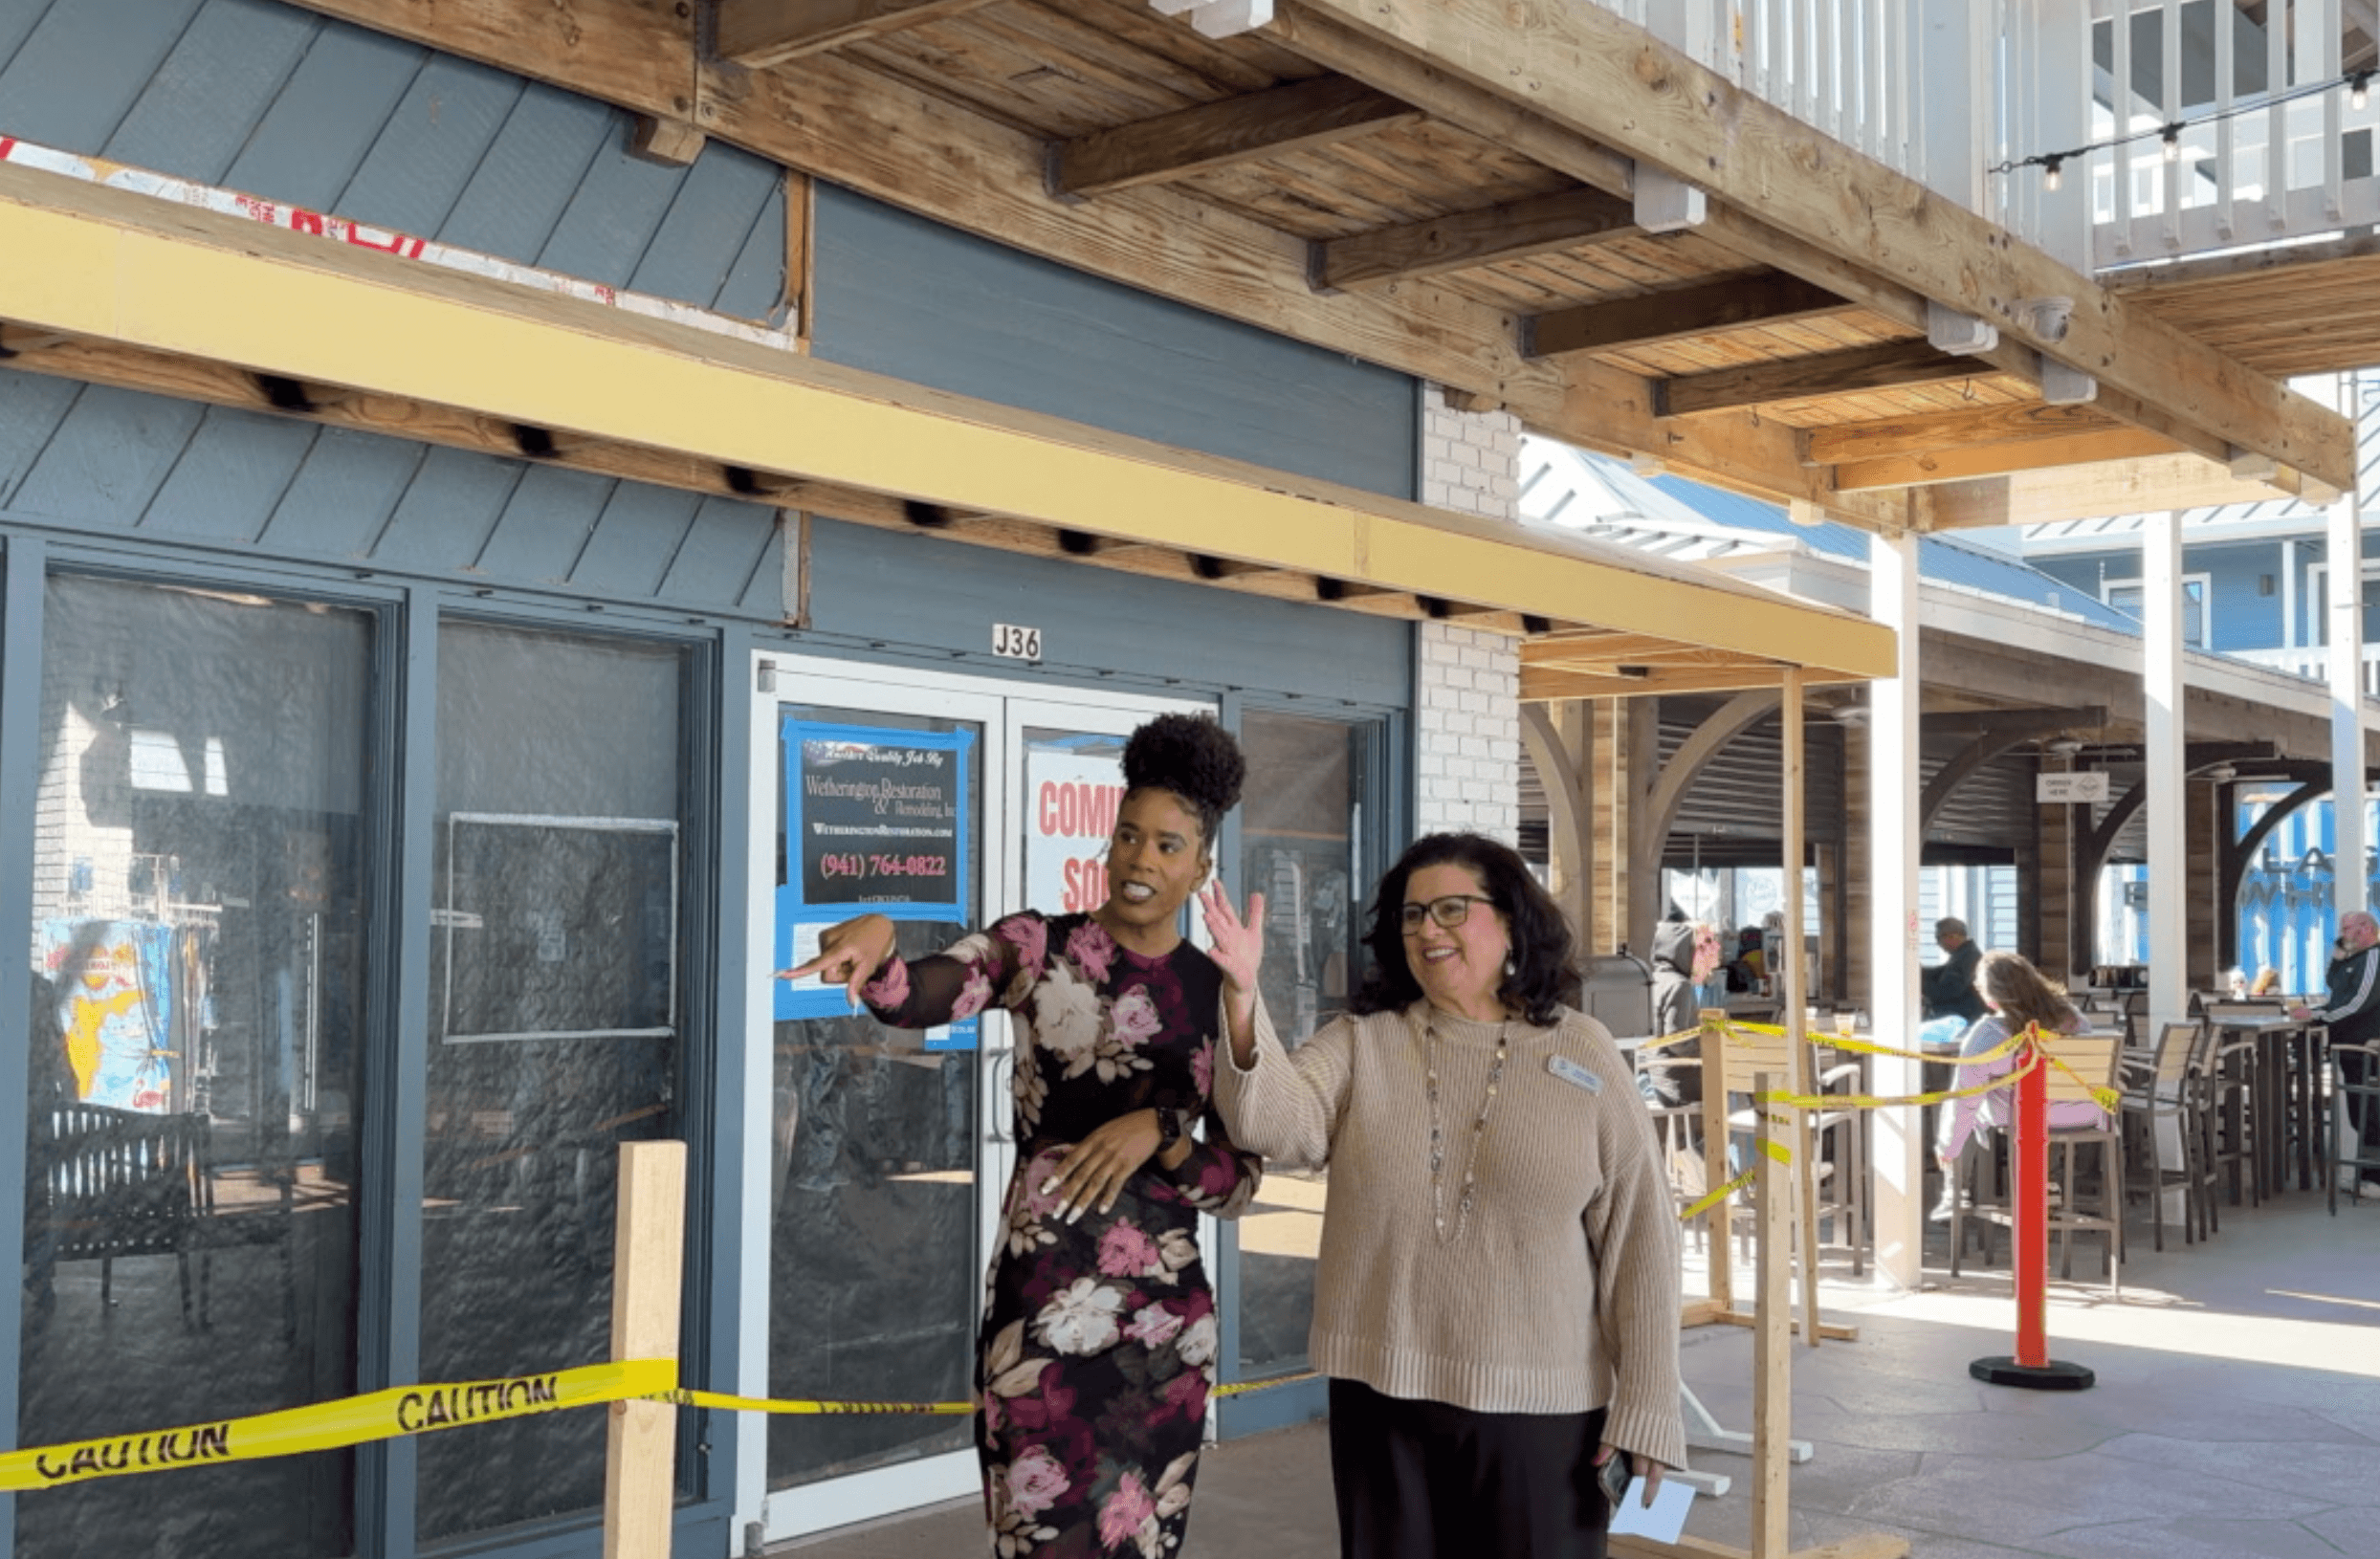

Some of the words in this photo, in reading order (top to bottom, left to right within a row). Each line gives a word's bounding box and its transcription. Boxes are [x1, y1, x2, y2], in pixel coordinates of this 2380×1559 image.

[996, 626, 1040, 657] J36
[866, 747, 902, 766] Quality
[902, 750, 923, 767] Job
[805, 774, 880, 801] Wetherington
[881, 777, 942, 801] Restoration
[874, 795, 890, 815] &
[1039, 780, 1126, 837] COMI
[821, 852, 865, 879] (941)
[869, 854, 947, 877] 764-0822
[397, 1375, 559, 1433] CAUTION
